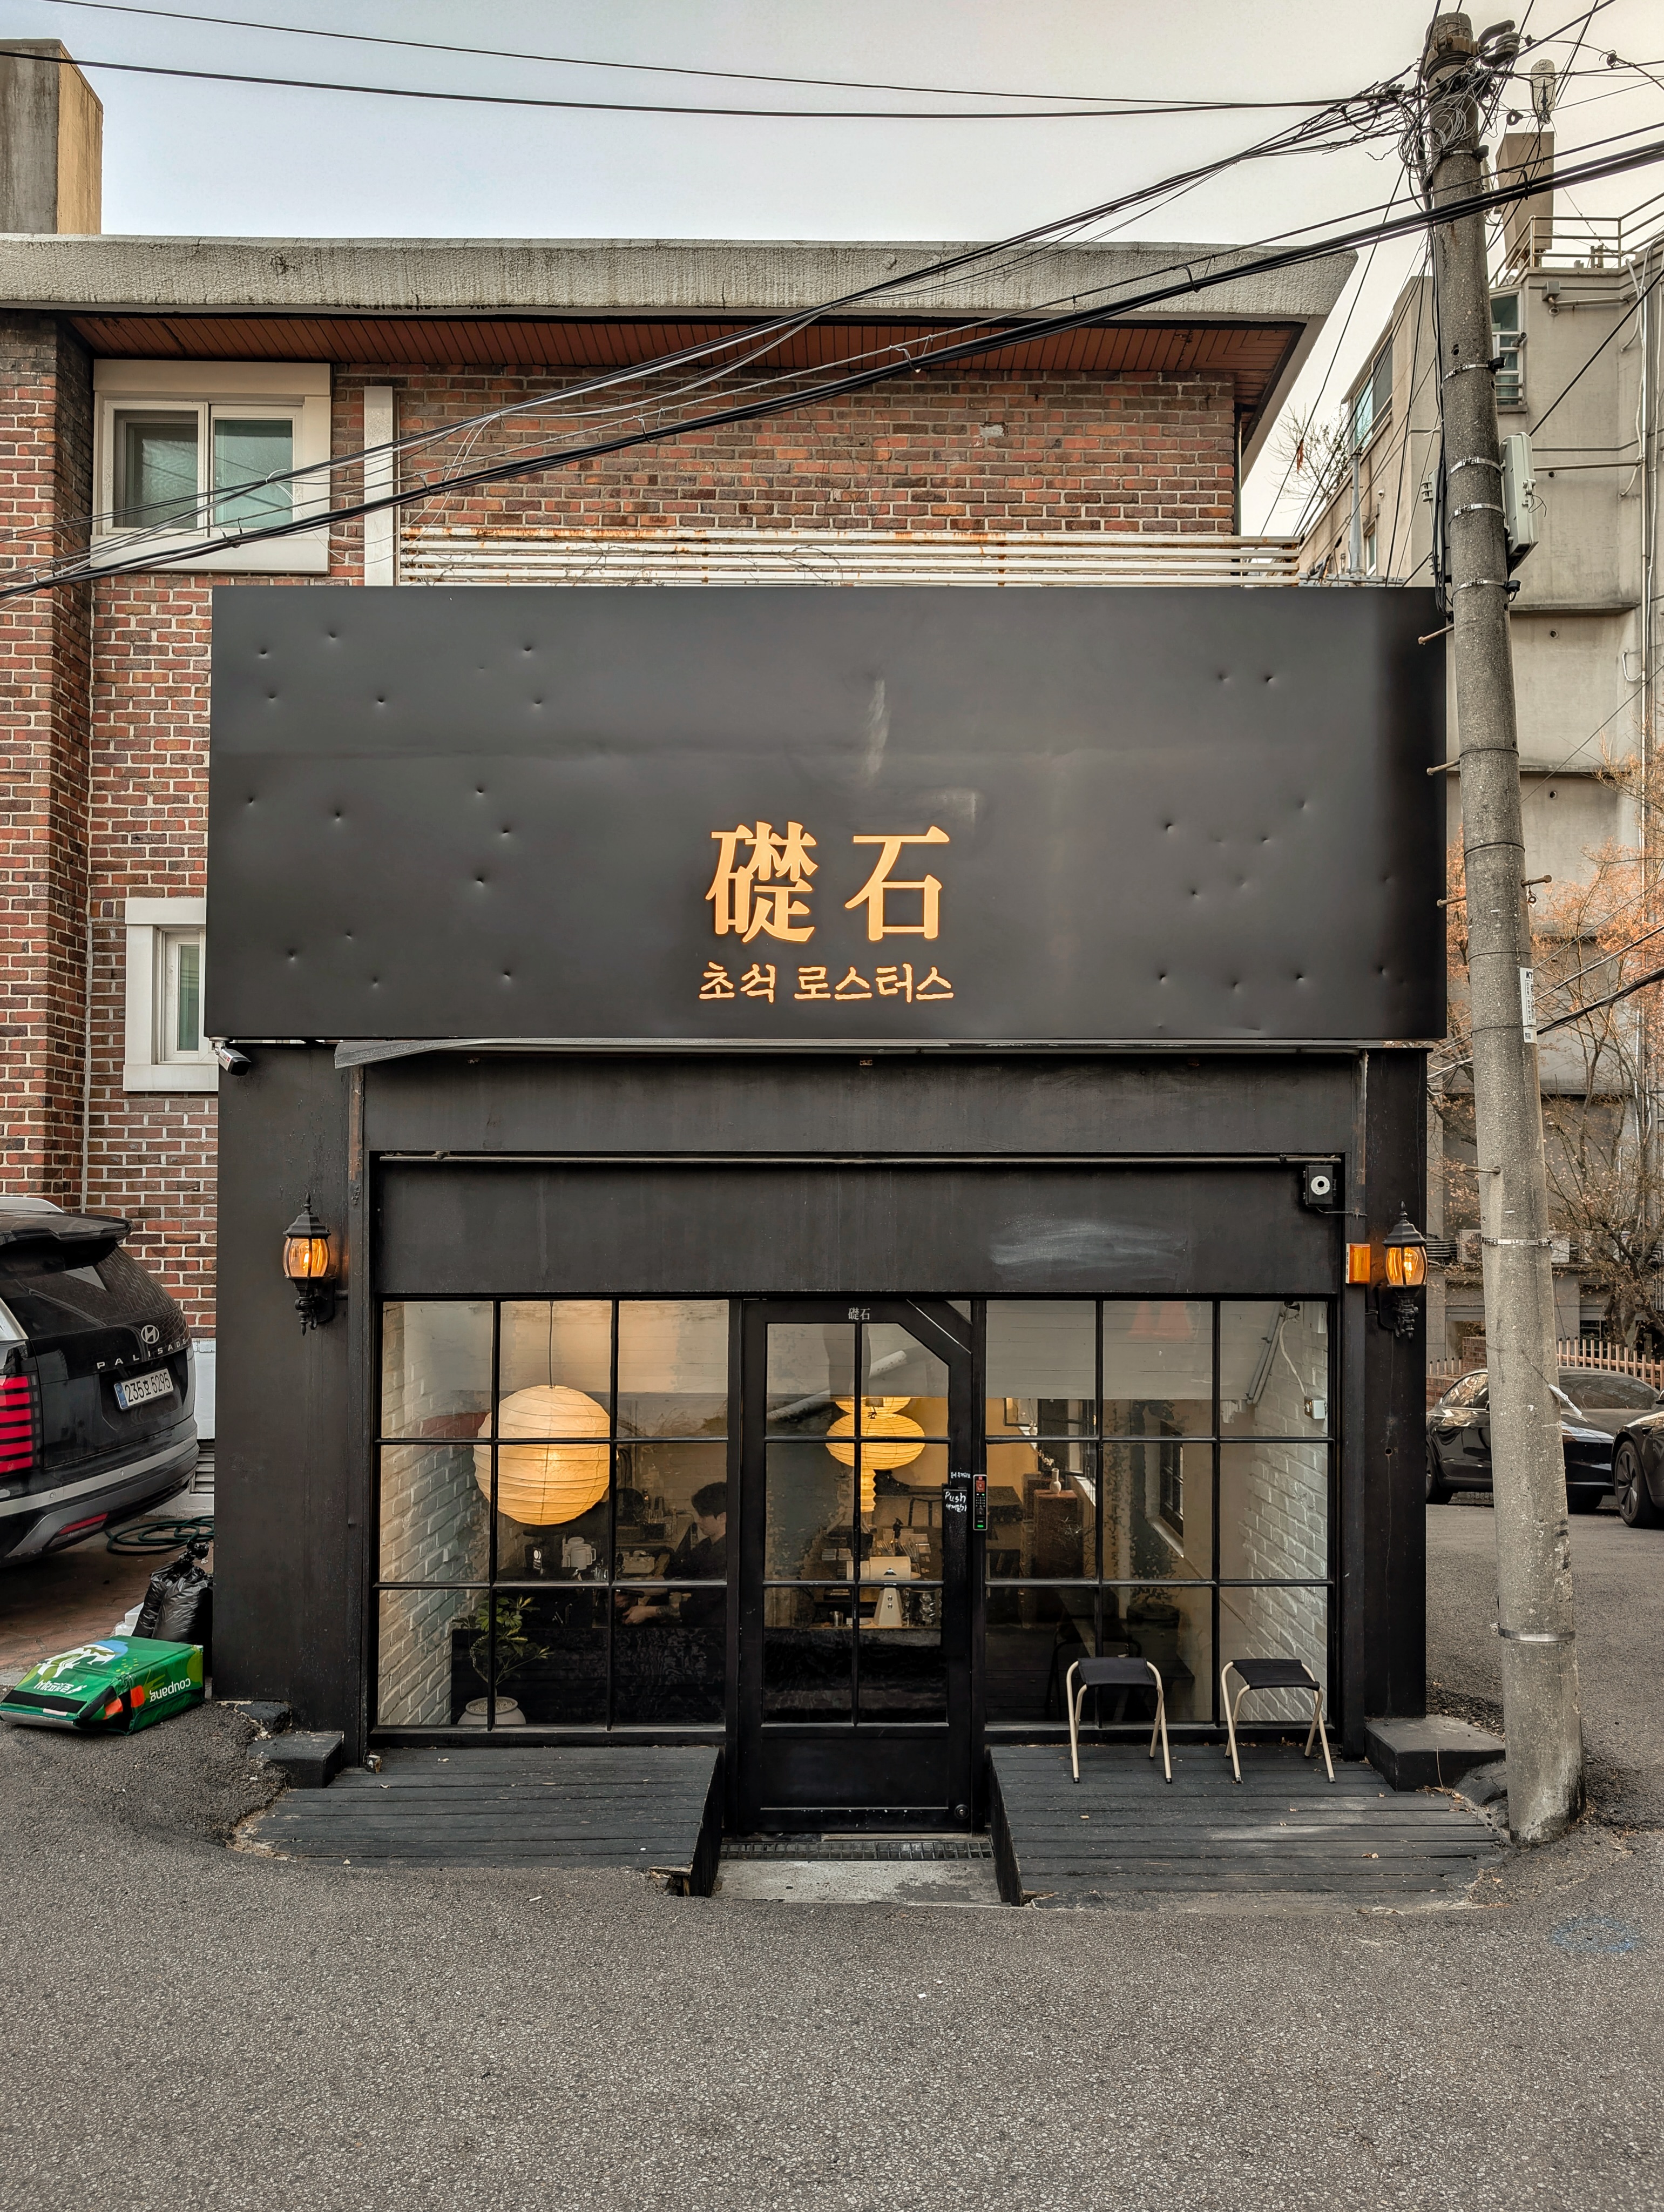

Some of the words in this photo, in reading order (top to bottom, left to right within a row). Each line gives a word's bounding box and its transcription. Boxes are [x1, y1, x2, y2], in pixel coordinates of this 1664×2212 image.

[705, 821, 950, 943] 礎石
[699, 962, 776, 1003] 초석
[794, 963, 955, 1003] 로스터스
[848, 1307, 871, 1320] 礎石
[97, 1338, 187, 1370] PALISADE
[150, 1372, 171, 1394] 5295
[945, 1491, 966, 1503] Push
[149, 1677, 191, 1703] coupang
